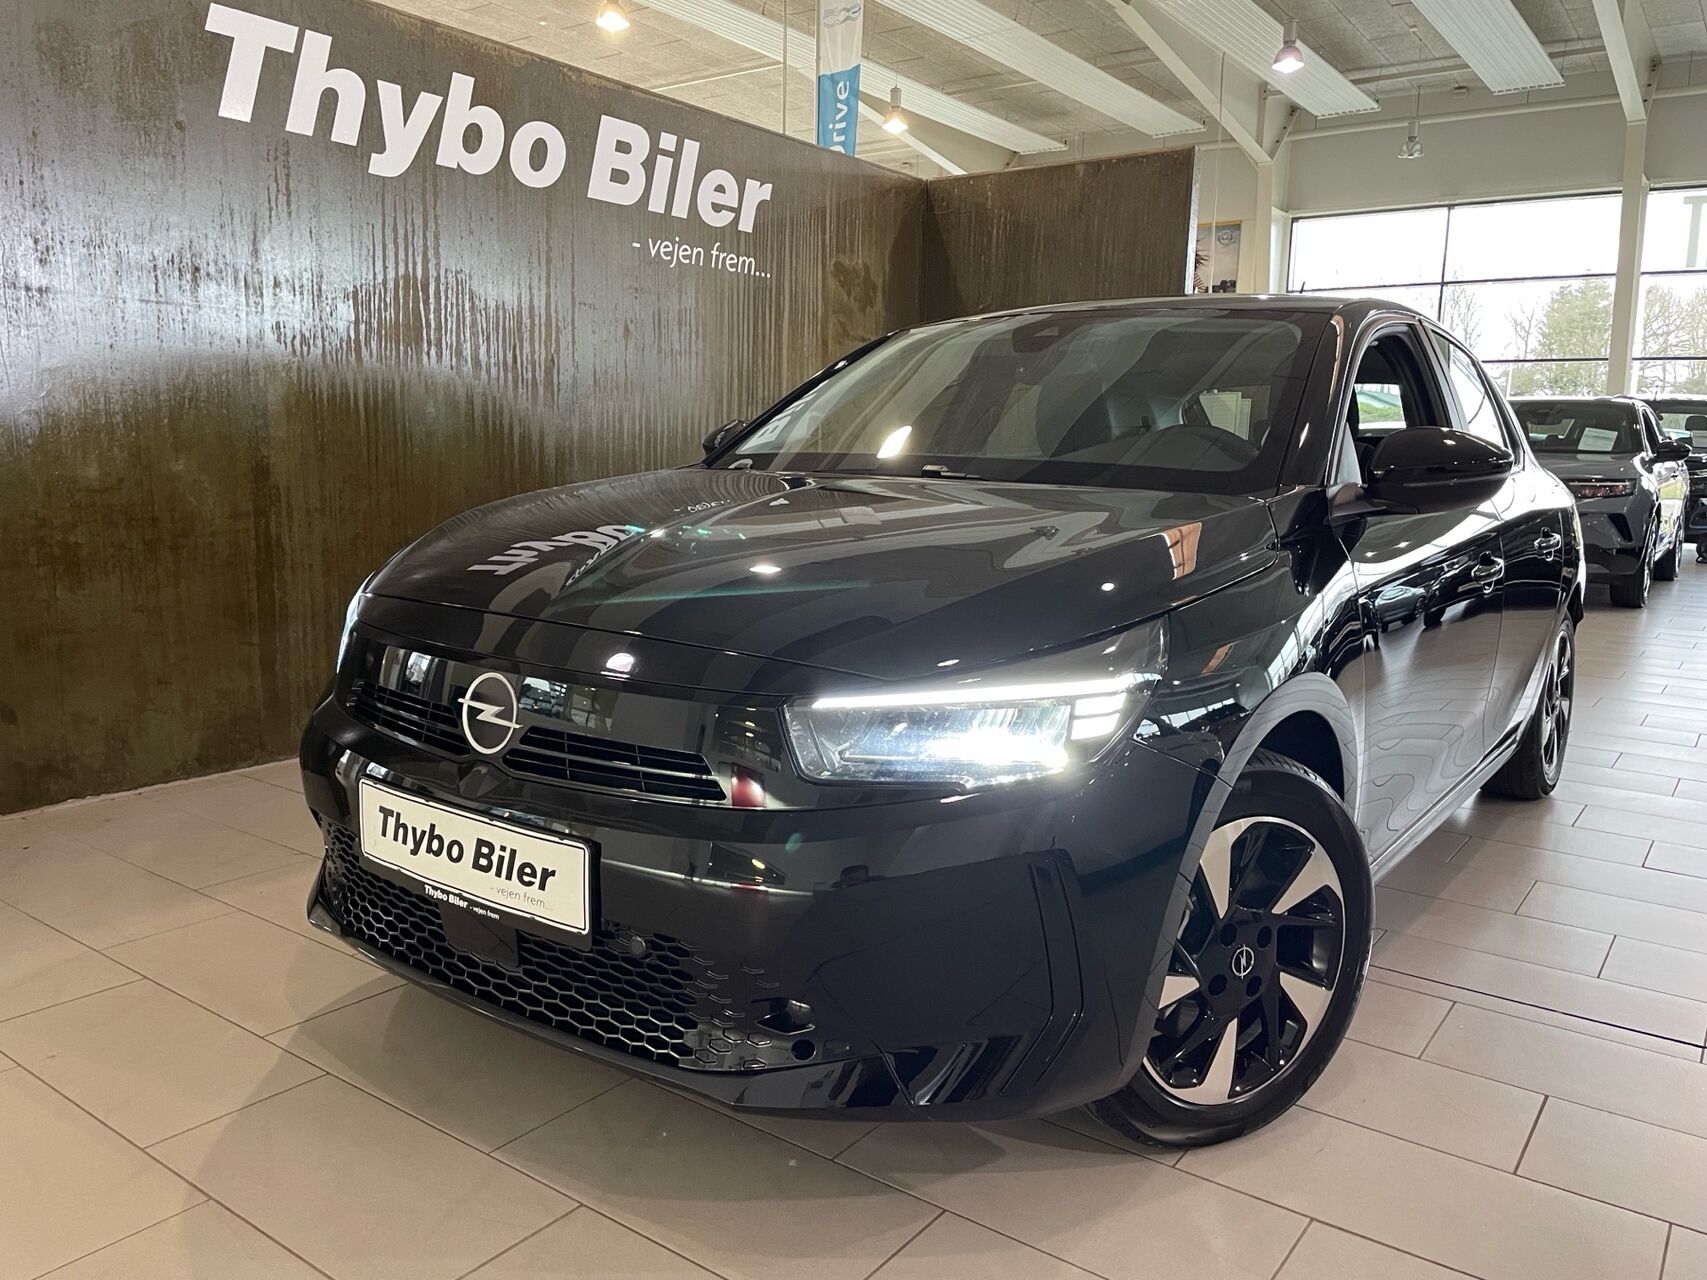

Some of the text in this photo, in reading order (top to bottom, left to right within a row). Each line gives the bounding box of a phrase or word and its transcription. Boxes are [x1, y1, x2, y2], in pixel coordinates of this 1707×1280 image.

[204, 3, 773, 233] Thybo Biler
[648, 236, 704, 268] vejen
[711, 242, 771, 278] frem...
[378, 805, 556, 892] Thybo Biler
[424, 884, 448, 901] Thybo
[448, 894, 469, 909] Biler
[472, 905, 487, 917] vejen
[486, 910, 500, 921] frem
[496, 886, 521, 902] vejen
